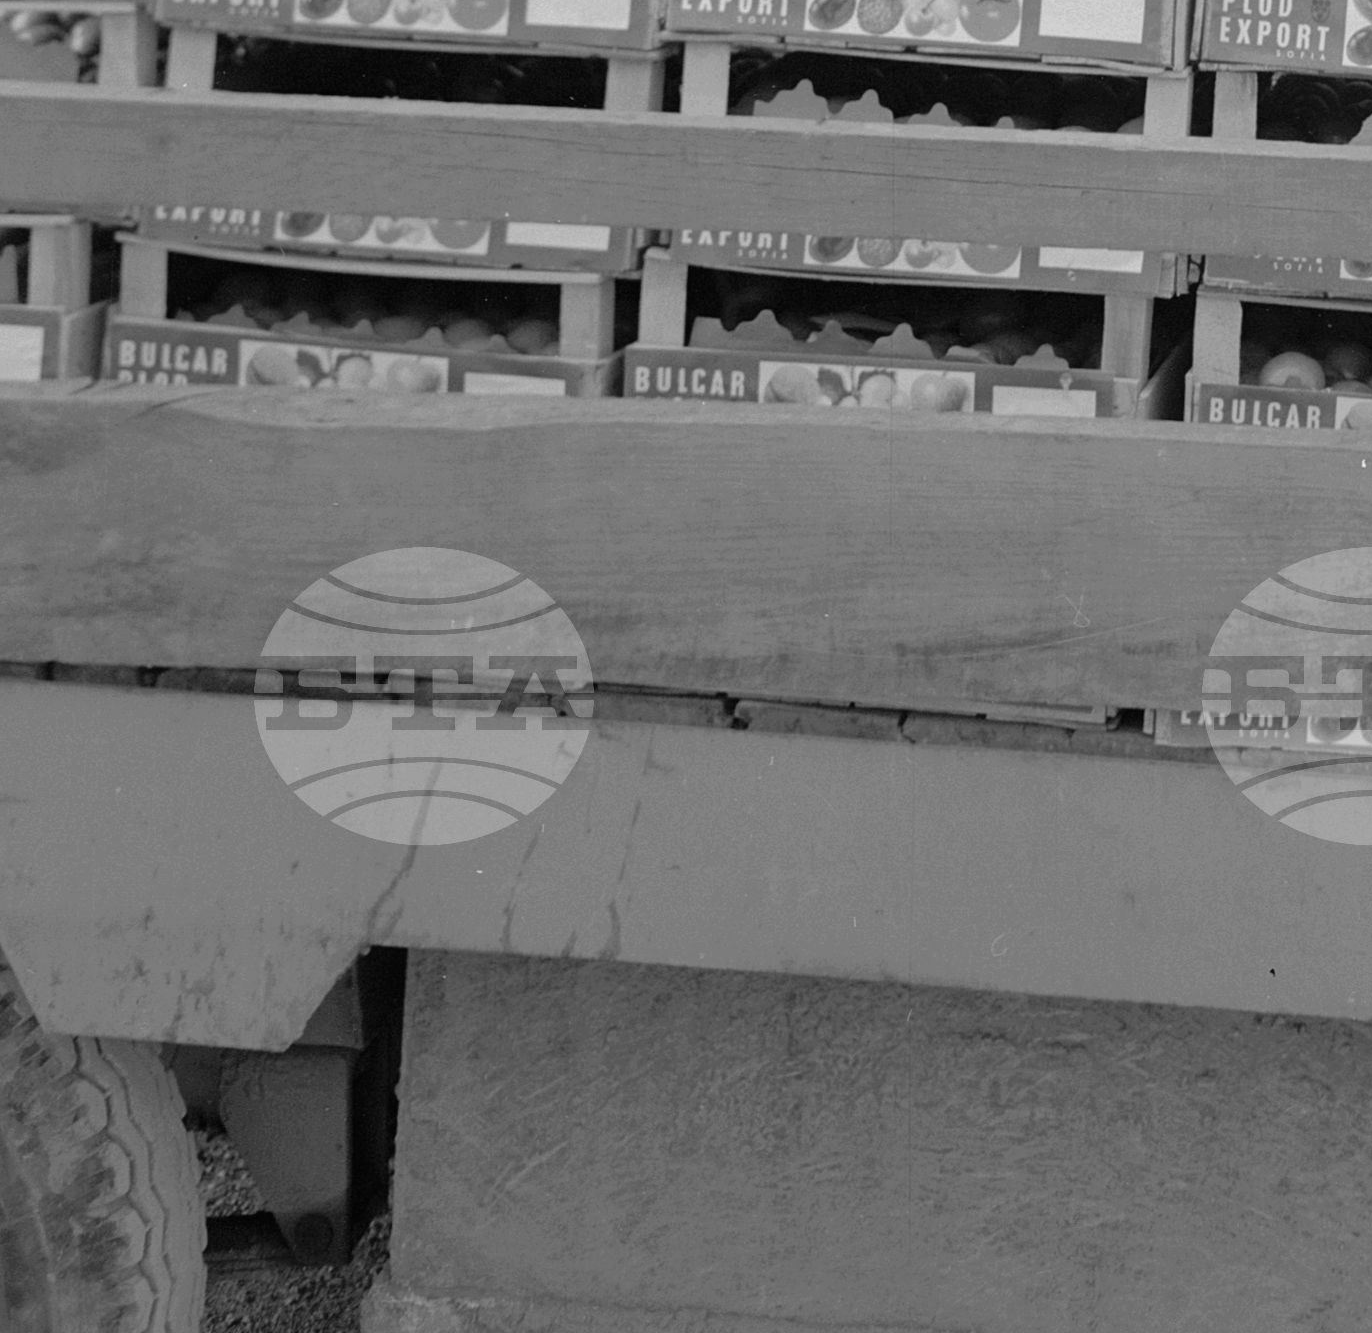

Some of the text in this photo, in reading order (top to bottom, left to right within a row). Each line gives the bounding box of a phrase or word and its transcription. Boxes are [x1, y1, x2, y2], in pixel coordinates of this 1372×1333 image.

[1219, 16, 1330, 52] EXPORT
[635, 365, 746, 398] BULGAR
[1208, 396, 1321, 429] BULGAR
